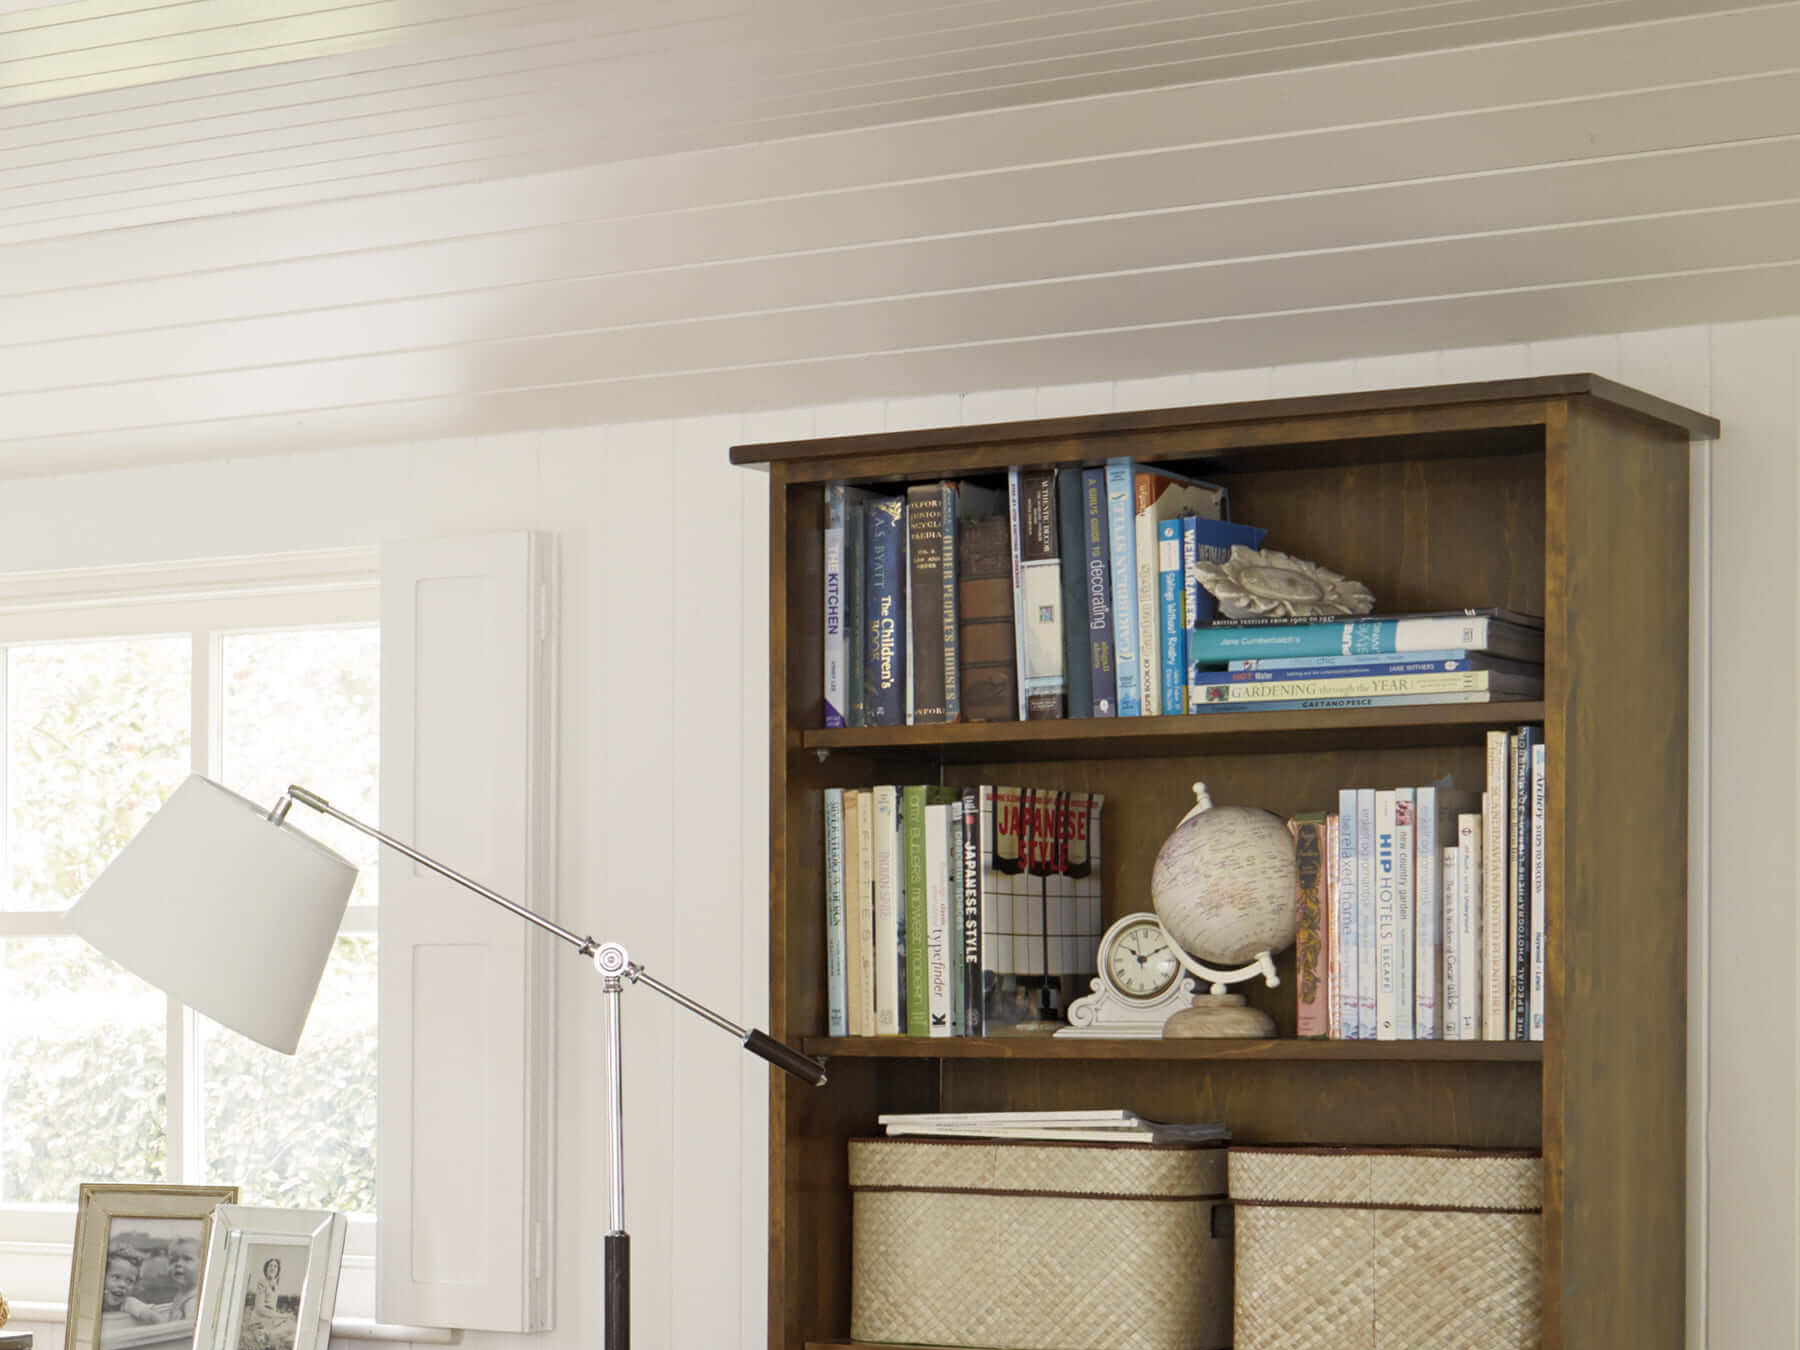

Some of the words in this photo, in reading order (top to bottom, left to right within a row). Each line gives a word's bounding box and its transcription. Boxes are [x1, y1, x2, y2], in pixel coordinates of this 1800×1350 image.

[873, 545, 885, 588] BYATT
[943, 535, 954, 579] OTHER
[1090, 560, 1110, 630] decorating
[1184, 529, 1196, 629] WEIMARANERS
[828, 573, 840, 635] KITCHEN
[880, 594, 891, 616] The
[944, 584, 955, 643] PEOPLE'S
[1115, 556, 1130, 652] CARIBBEAN
[1167, 603, 1177, 633] Without
[880, 617, 894, 689] Children's
[944, 647, 956, 701] HOUSES
[1231, 683, 1318, 699] GARDENING
[1371, 679, 1409, 693] YEAR
[1301, 700, 1345, 709] GAETANO
[1345, 698, 1373, 706] PESCE
[1534, 776, 1544, 818] Archery
[998, 805, 1087, 841] JAPANESE
[1400, 831, 1408, 849] new
[1017, 839, 1070, 874] STYLE
[1342, 832, 1353, 886] relaxed
[1379, 833, 1393, 873] HIP
[1399, 853, 1409, 886] country
[964, 842, 977, 916] JAPANESE
[1535, 862, 1543, 893] SUCCESS
[1342, 890, 1352, 936] home
[1380, 876, 1393, 940] HOTELS
[1399, 889, 1409, 920] garden
[928, 929, 946, 997] typefinder
[965, 920, 978, 964] STYLE
[1383, 947, 1392, 989] ESCAPE
[1516, 968, 1526, 1013] SPECIAL
[1516, 1018, 1526, 1039] THE
